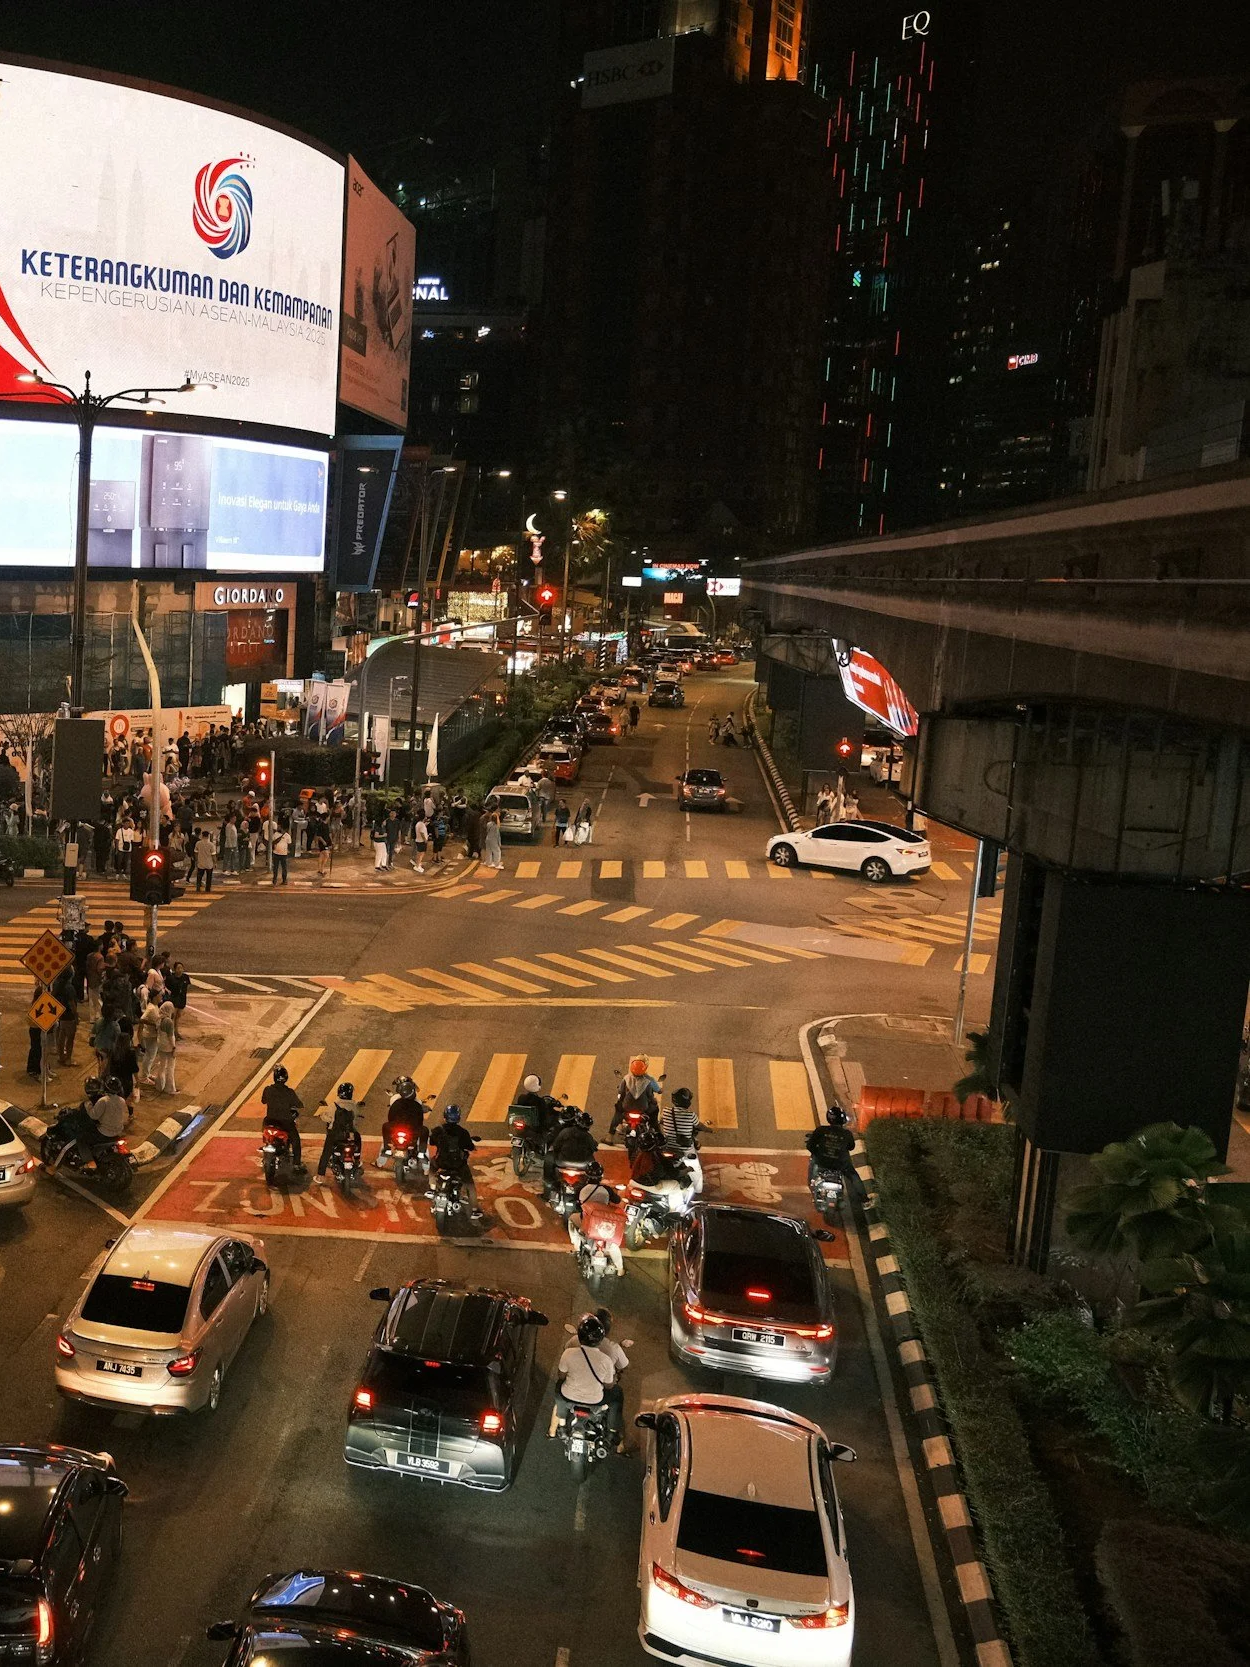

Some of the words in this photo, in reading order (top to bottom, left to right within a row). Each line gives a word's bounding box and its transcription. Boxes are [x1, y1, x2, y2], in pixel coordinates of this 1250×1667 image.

[902, 11, 930, 40] EQ
[588, 65, 635, 86] HSBC
[353, 178, 364, 198] acer
[21, 249, 213, 300] KETERANGKUMAN
[219, 278, 249, 307] DAN
[254, 286, 333, 331] KEMAMPANAN
[41, 282, 195, 317] KEPENGERUSIAN
[199, 303, 304, 340] ASEAN-MALAYSIA
[306, 327, 326, 346] 2025
[1019, 353, 1039, 367] CIMB
[184, 369, 250, 387] #MyASEAN2025
[218, 492, 247, 508] Inovasi
[248, 496, 273, 513] Elegan
[273, 499, 293, 511] untuk
[356, 482, 367, 541] PREDATOR
[214, 586, 283, 605] GIORDANO
[742, 1332, 756, 1342] QRW
[760, 1335, 775, 1344] 2115
[103, 1362, 117, 1371] ANJ
[118, 1364, 135, 1374] 7435
[407, 1456, 421, 1467] VLB
[421, 1459, 439, 1470] 3592
